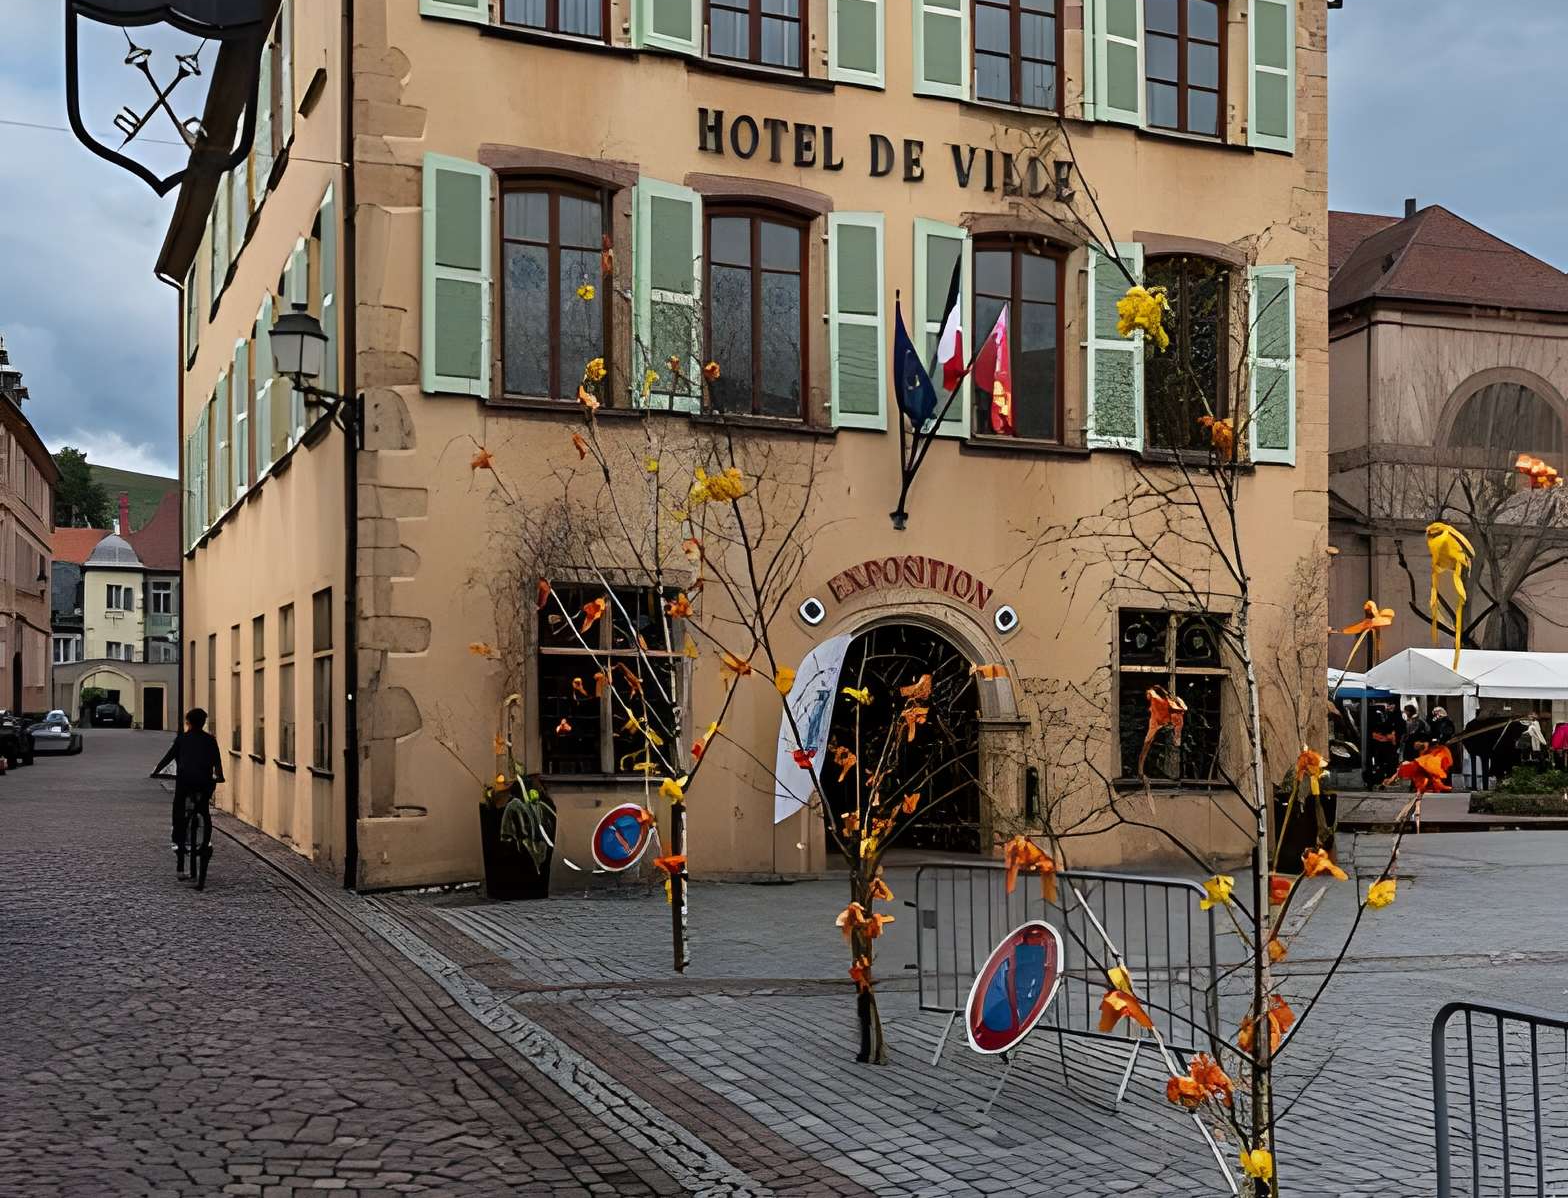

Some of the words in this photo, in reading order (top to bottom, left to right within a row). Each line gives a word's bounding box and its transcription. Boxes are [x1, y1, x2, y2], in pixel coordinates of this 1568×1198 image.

[697, 107, 844, 171] HOTEL
[869, 134, 925, 182] DE
[826, 555, 994, 610] EXPOSITION
